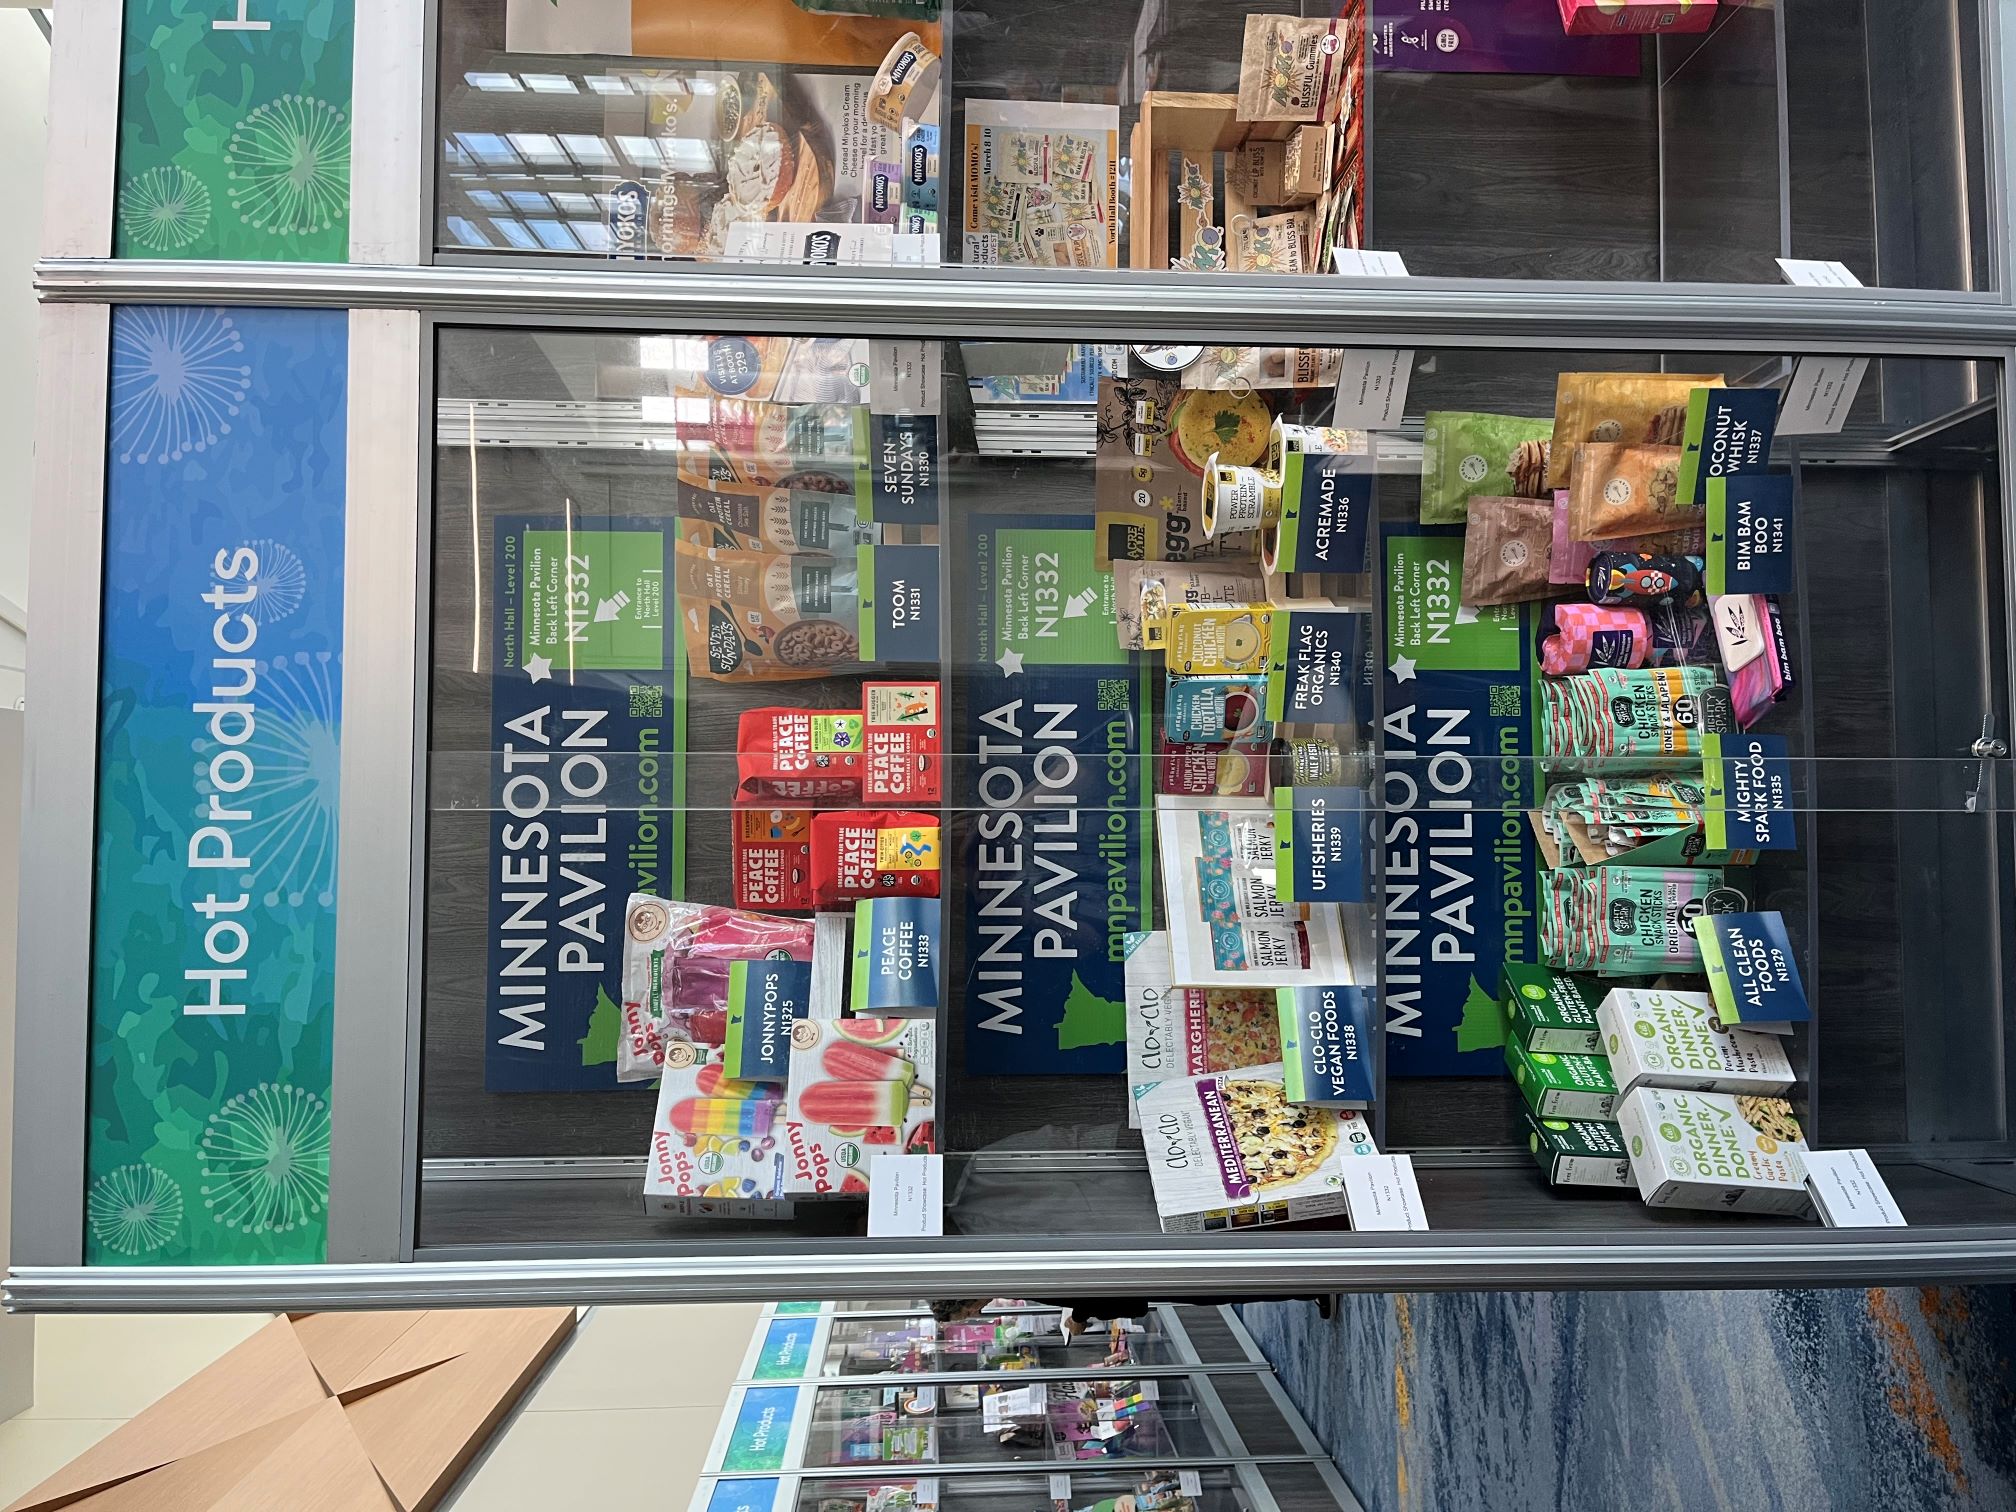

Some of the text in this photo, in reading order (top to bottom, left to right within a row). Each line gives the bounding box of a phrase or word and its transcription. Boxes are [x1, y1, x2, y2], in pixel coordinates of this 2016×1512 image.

[890, 51, 914, 82] MIYOKO'S
[1306, 34, 1319, 70] Gummies
[1300, 73, 1314, 108] BLISSFUL
[841, 84, 851, 176] Spread Miyoko's Cream
[850, 82, 861, 178] Cheese on your morning
[860, 135, 868, 146] for
[913, 147, 924, 182] MIYOKO'S
[970, 142, 979, 229] Come visit MOMO's!
[875, 174, 885, 209] MIYOKO'S
[1108, 181, 1117, 244] North Hall Booth
[1287, 231, 1296, 248] BLISS
[713, 349, 727, 385] VISIT US
[724, 344, 738, 385] AT BOOTH
[735, 350, 748, 374] 329
[1709, 405, 1732, 476] OCONUT
[1726, 420, 1748, 473] WHISK
[1746, 429, 1762, 464] N1337
[883, 442, 898, 494] SEVEN
[900, 432, 915, 505] SUNDAYS
[918, 451, 930, 486] N1330
[1230, 489, 1239, 520] POWER
[1247, 476, 1256, 519] SCRAMBLE
[1315, 468, 1336, 561] ACREMADE
[1336, 497, 1350, 533] N1336
[1127, 526, 1138, 559] ACRE
[1737, 501, 1751, 571] BIM BAM
[1754, 517, 1768, 554] BOO
[1772, 517, 1783, 553] N1341
[504, 535, 516, 668] North Hall Level 200
[529, 548, 542, 646] Minnesota Pavilion
[546, 556, 558, 644] Back Left Corner
[564, 554, 590, 642] N1332
[892, 580, 906, 629] TOOM
[910, 588, 922, 621] N1331
[978, 534, 988, 662] North Hall Level 200
[1001, 546, 1013, 641] Minnesota Pavilion
[1018, 554, 1029, 640] Back Left Corner
[1034, 552, 1059, 637] N1332
[1394, 553, 1405, 647] Minnesota Pavilion
[1410, 561, 1421, 646] Back Left Corner
[1426, 559, 1451, 644] N1332
[710, 624, 722, 659] SEVEN
[720, 621, 738, 672] SUNDAYS
[1192, 623, 1204, 662] COCONUT
[1203, 618, 1217, 667] CHICKEN
[1295, 624, 1313, 710] FREAK FLAG
[1773, 617, 1792, 682] bim bam boo
[1311, 630, 1328, 706] ORGANICS
[1329, 651, 1342, 686] N1340
[1190, 694, 1201, 730] CHICKEN
[1200, 687, 1216, 737] TORTILLA
[1632, 684, 1651, 740] CHICKEN
[1645, 685, 1660, 738] SNACK STICKS
[1675, 699, 1693, 724] 60
[778, 714, 794, 771] PEACE
[874, 732, 889, 793] PEACE
[1192, 743, 1206, 793] CHICKEN
[183, 546, 259, 1016] Hot Products
[1183, 769, 1192, 790] LEMON
[1734, 760, 1751, 822] MIGHTY
[1749, 741, 1770, 843] SPARK FOOD
[1771, 775, 1784, 810] N1335
[628, 728, 660, 896] vilion.com
[1032, 702, 1079, 958] PAVILION
[1427, 708, 1476, 962] PAVILION
[557, 710, 609, 973] PAVILION
[844, 828, 860, 888] PEACE
[976, 698, 1024, 1035] MINNESOTA
[1098, 720, 1136, 962] mnpavilion.com
[1258, 834, 1274, 861] JERKY
[1312, 798, 1326, 890] UFISHERIES
[1330, 826, 1342, 862] N1339
[1494, 726, 1531, 964] mnpavilion.com
[497, 705, 551, 1052] MINNESOTA
[748, 848, 764, 903] PEACE
[1385, 703, 1424, 1038] MINNESOTA
[1250, 878, 1269, 918] SALMON
[1613, 901, 1624, 932] MIGHTY
[1639, 888, 1655, 947] CHICKEN
[1651, 890, 1664, 945] SNACK STICKS
[880, 927, 896, 975] PEACE
[898, 922, 914, 980] COFFEE
[918, 934, 930, 968] N1333
[1257, 930, 1274, 966] SALMON
[1272, 937, 1288, 966] JERKY
[1666, 905, 1679, 954] ORIGINAL
[1728, 927, 1763, 1007] ALL CLEAN
[1750, 938, 1777, 992] FOODS
[1770, 948, 1790, 982] N1329
[760, 973, 779, 1064] JONNYPOPS
[780, 1000, 793, 1036] N1325
[1548, 987, 1573, 1024] ORGANIC.
[1552, 975, 1584, 1024] GLUTEN-FREE.
[1564, 976, 1595, 1024] PLANT-BASED.
[624, 1001, 649, 1057] Jonny
[644, 1022, 665, 1066] Pops
[1308, 1011, 1328, 1075] CLO-CLO
[1322, 990, 1346, 1096] VEGAN FOODS
[1343, 1024, 1358, 1060] N1338
[1648, 993, 1686, 1070] ORGANIC.
[1669, 1004, 1704, 1070] DINNER.
[1692, 1020, 1722, 1071] DONE.
[1727, 1033, 1747, 1073] Mushroom
[1719, 1045, 1734, 1072] Porcini
[1745, 1052, 1759, 1074] Pasta
[654, 1130, 676, 1185] Jonny
[785, 1121, 813, 1182] Jonny
[1204, 1090, 1242, 1184] MEDITERRANEAN
[1673, 1094, 1713, 1177] ORGANIC.
[1696, 1108, 1732, 1178] DINNER.
[1720, 1125, 1751, 1179] DONE.
[674, 1151, 694, 1197] Pops
[808, 1142, 833, 1194] Pops
[1748, 1150, 1763, 1180] Creamy
[1762, 1157, 1776, 1181] Garlic
[1774, 1160, 1788, 1182] Pasta
[776, 1332, 798, 1365] Hot Products
[749, 1407, 776, 1451] Hot Products
